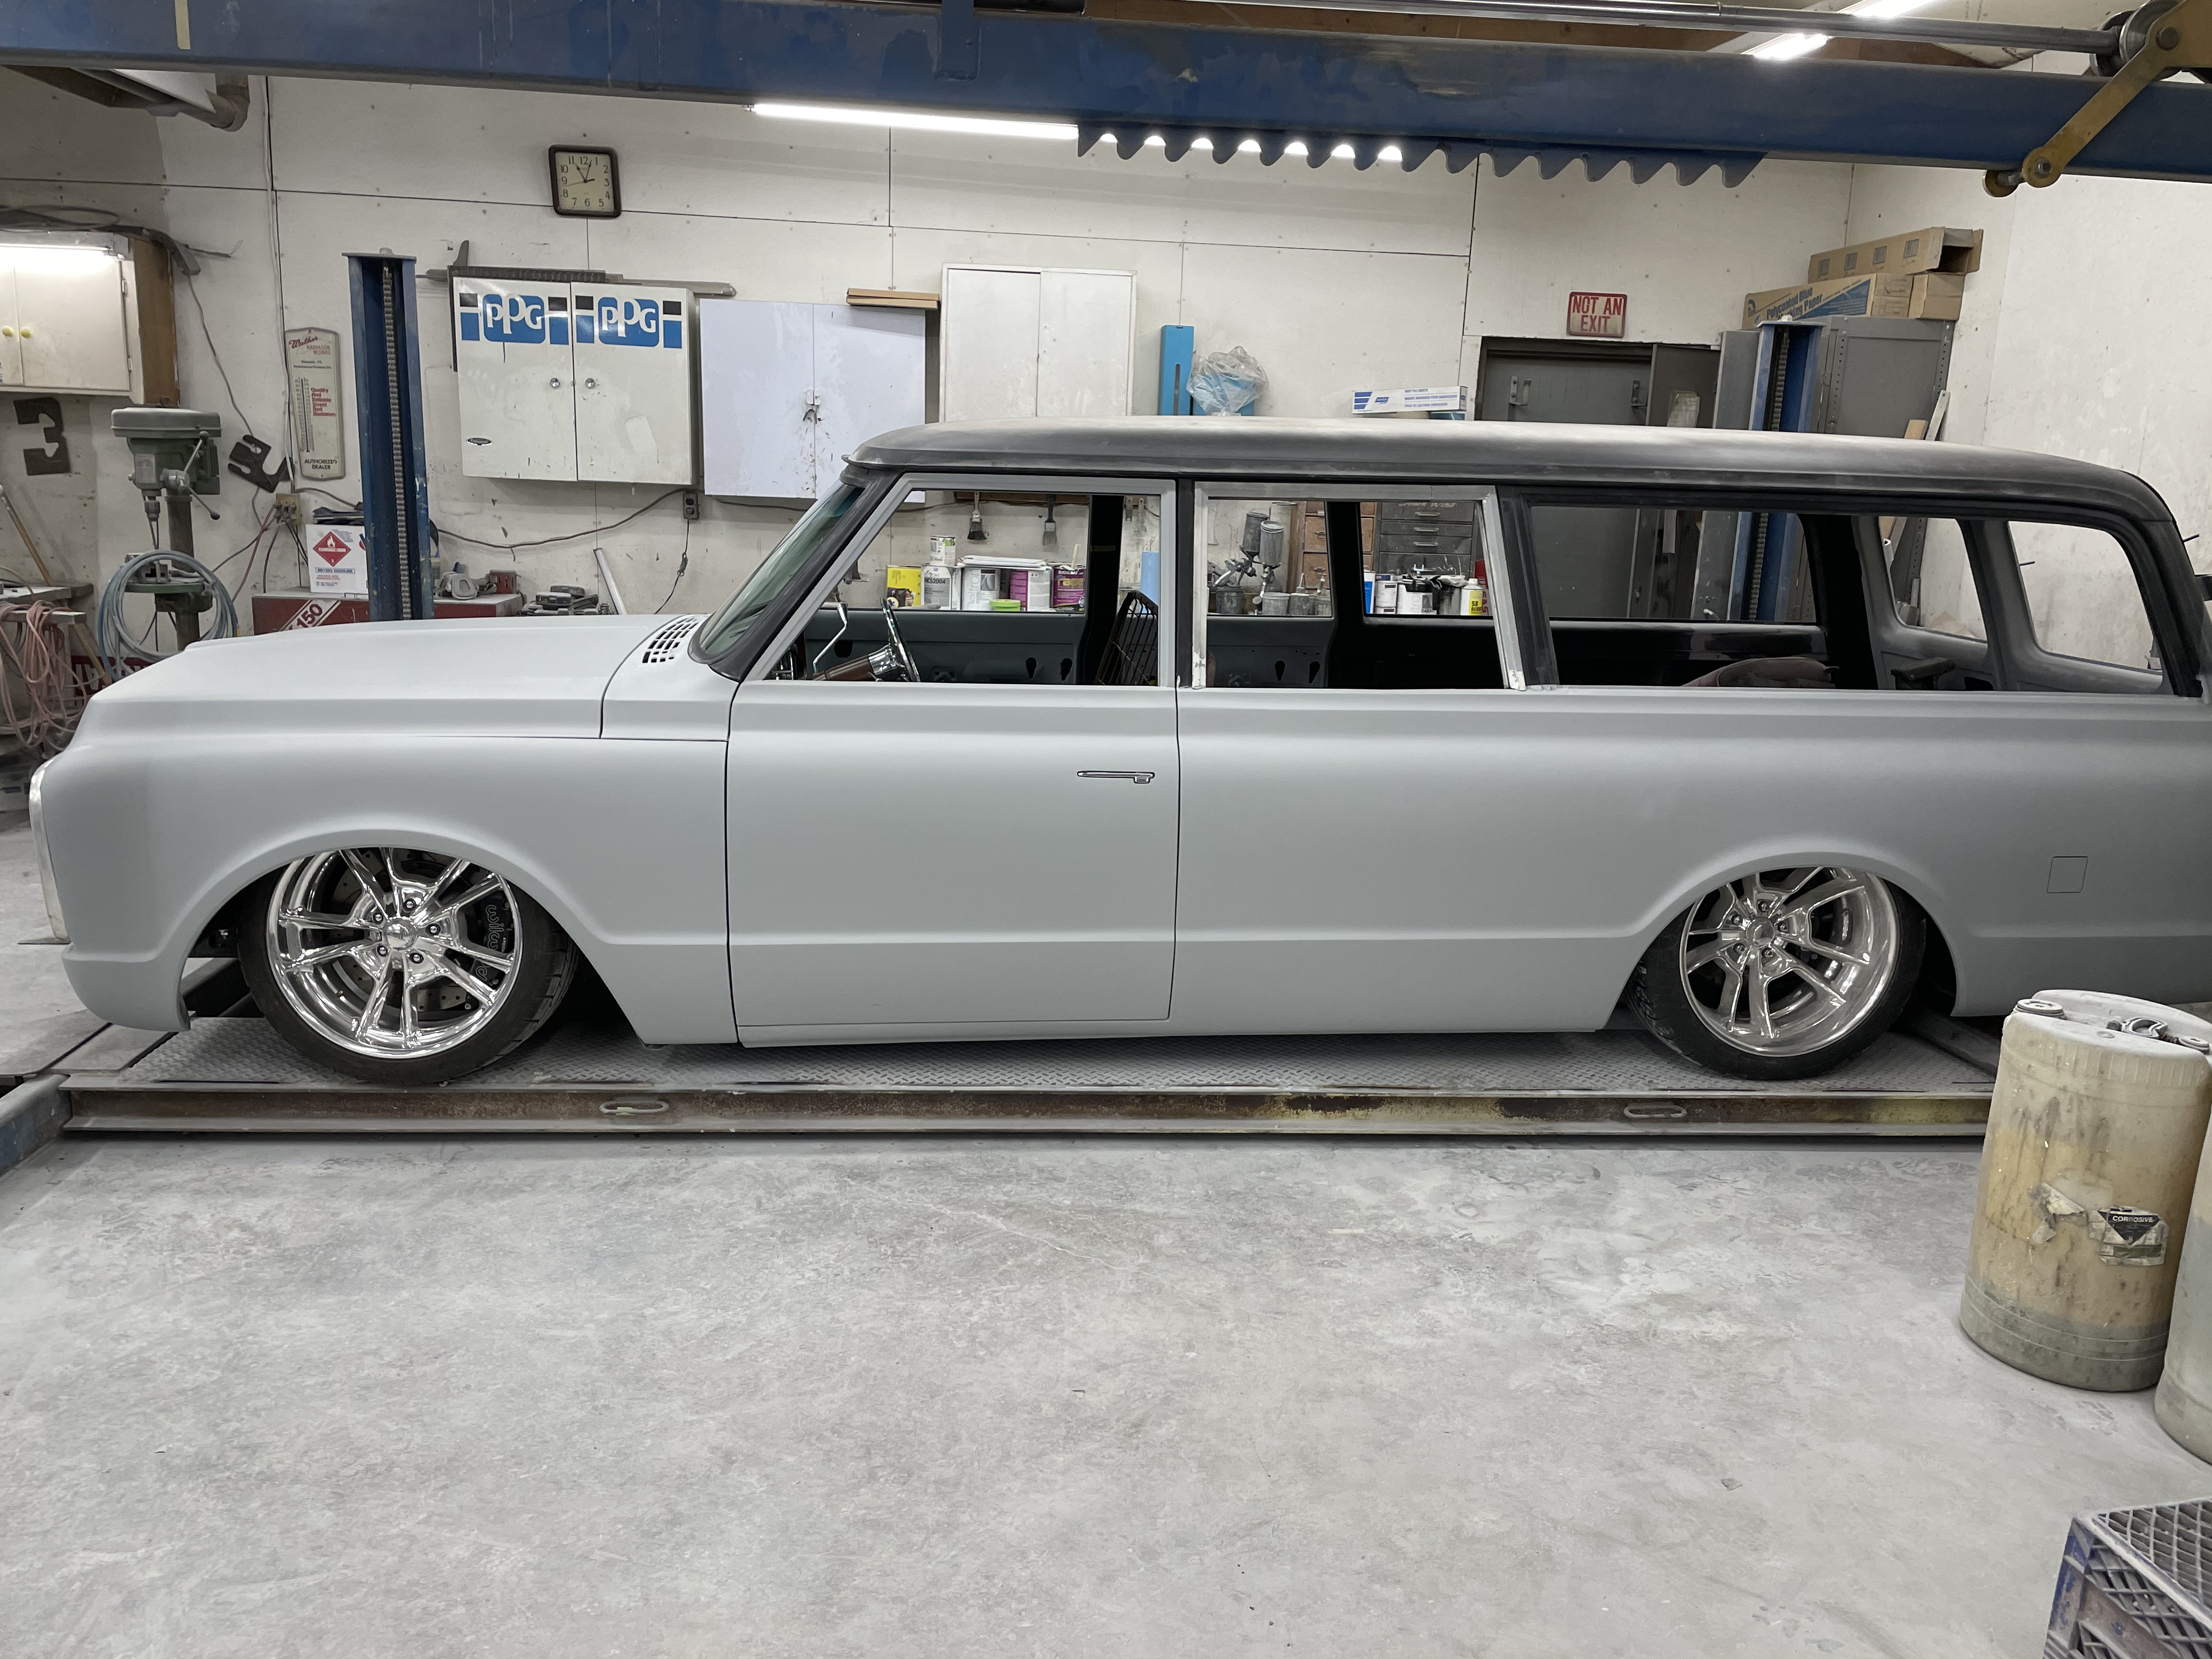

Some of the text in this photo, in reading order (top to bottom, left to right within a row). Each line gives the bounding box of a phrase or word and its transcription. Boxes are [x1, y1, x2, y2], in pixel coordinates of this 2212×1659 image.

[568, 155, 574, 165] 11
[580, 156, 589, 165] 12
[560, 164, 568, 173] 10
[603, 165, 609, 173] 2
[561, 176, 567, 185] 9
[604, 178, 610, 187] 3
[563, 189, 568, 198] 8
[605, 190, 611, 199] 4
[584, 198, 590, 207] 6
[598, 199, 604, 207] 5
[1572, 296, 1622, 315] NOT AN
[1767, 292, 1798, 320] Polycoated
[1799, 287, 1813, 303] Blue
[1804, 294, 1822, 312] Paper
[1581, 315, 1611, 333] EXIT
[476, 905, 505, 981] wilwd
